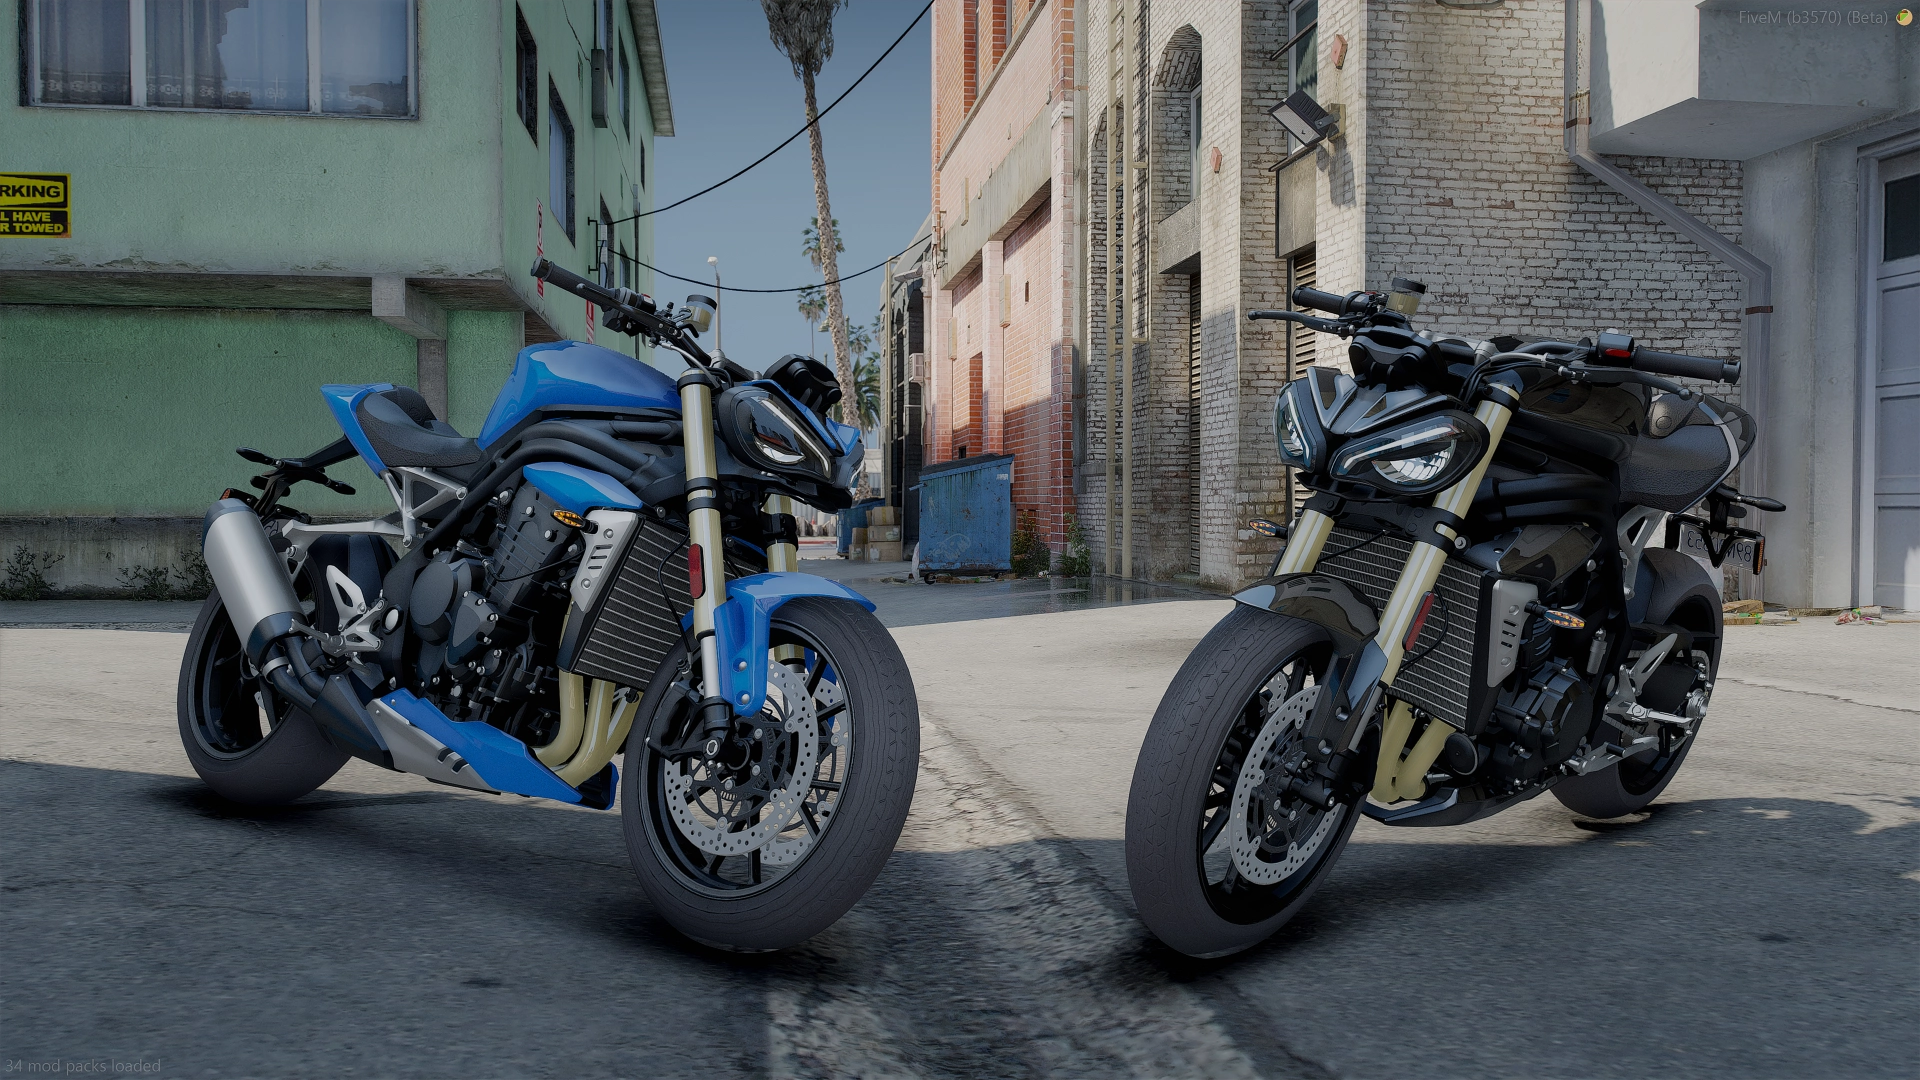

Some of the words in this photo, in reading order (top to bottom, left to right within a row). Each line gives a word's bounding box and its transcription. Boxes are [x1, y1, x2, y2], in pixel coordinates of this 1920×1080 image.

[0, 184, 60, 198] RKING
[13, 211, 51, 222] HAVE
[13, 223, 64, 233] TOWED
